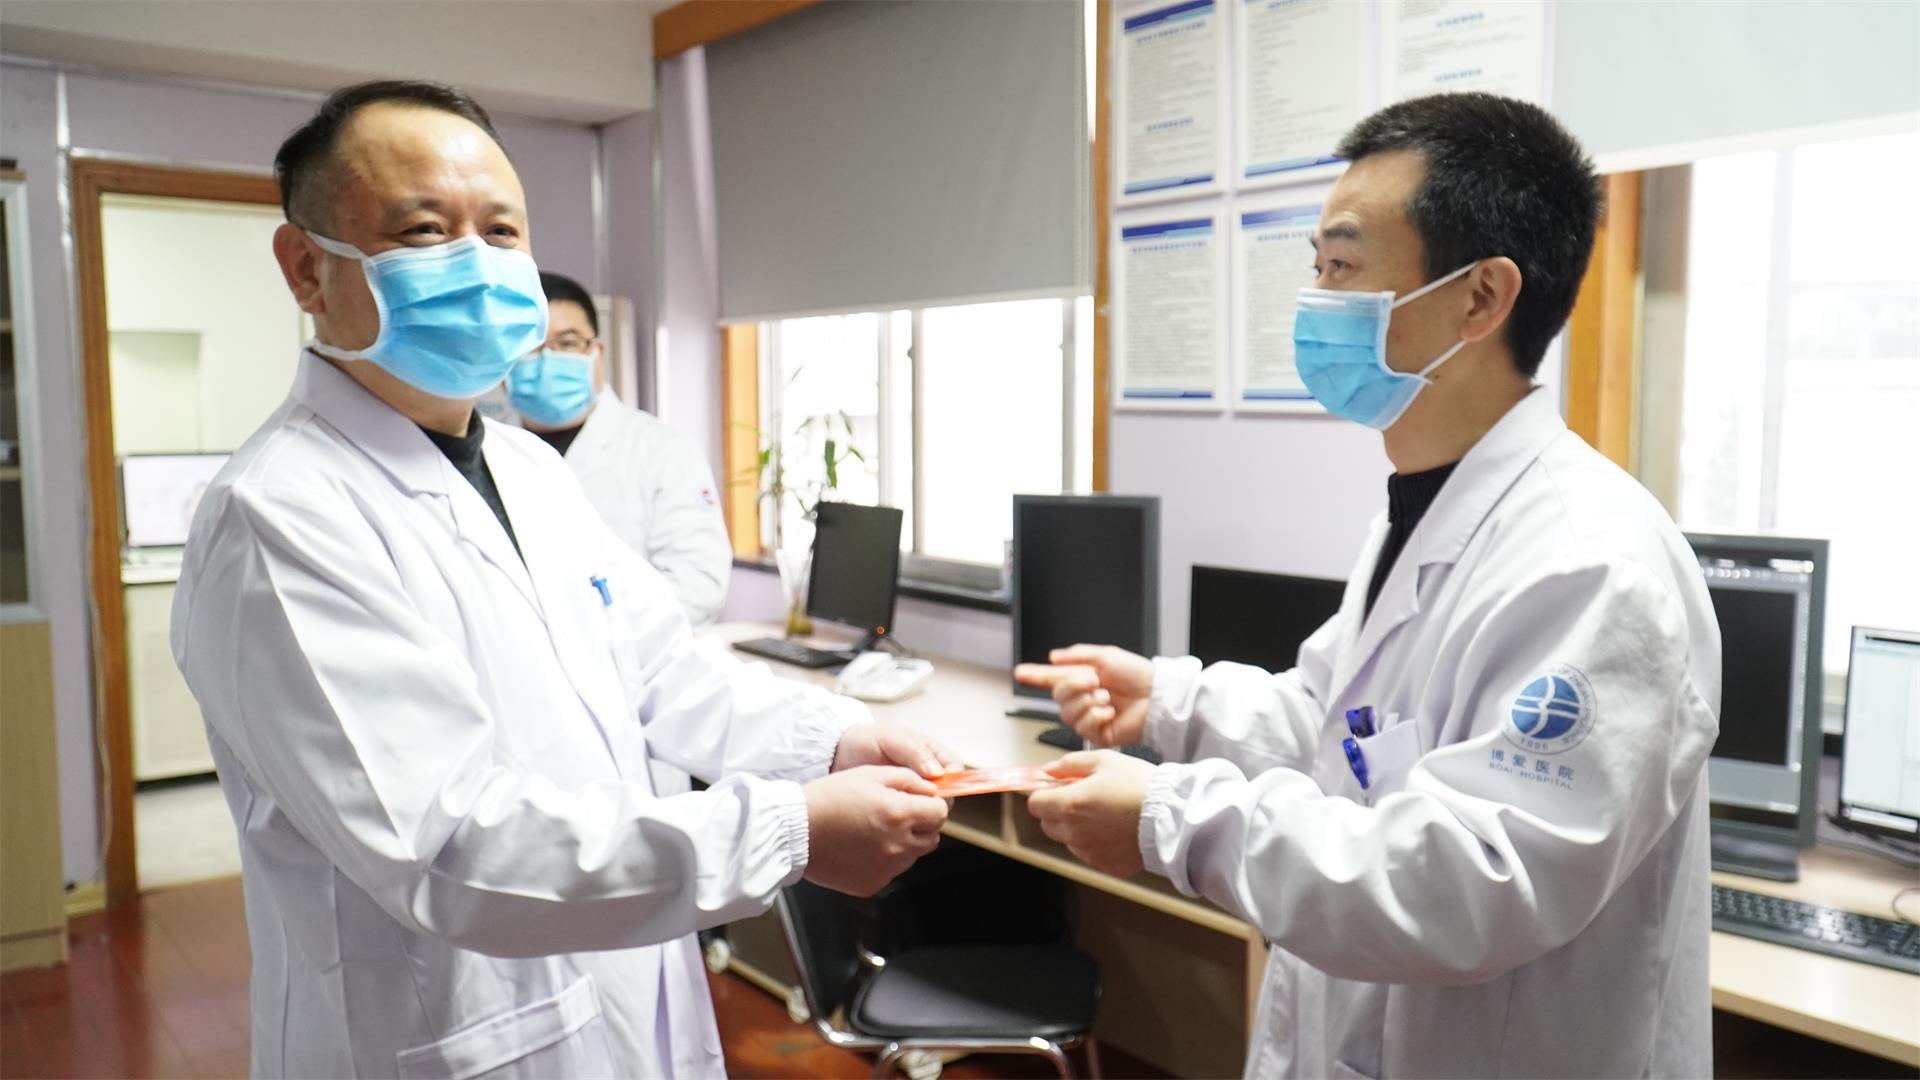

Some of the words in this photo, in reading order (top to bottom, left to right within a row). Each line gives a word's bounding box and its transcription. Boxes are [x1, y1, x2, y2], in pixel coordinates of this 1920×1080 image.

[1489, 761, 1513, 774] BOAI
[1520, 770, 1573, 791] HOSPITAL
[1491, 748, 1574, 780] 博爱医院
